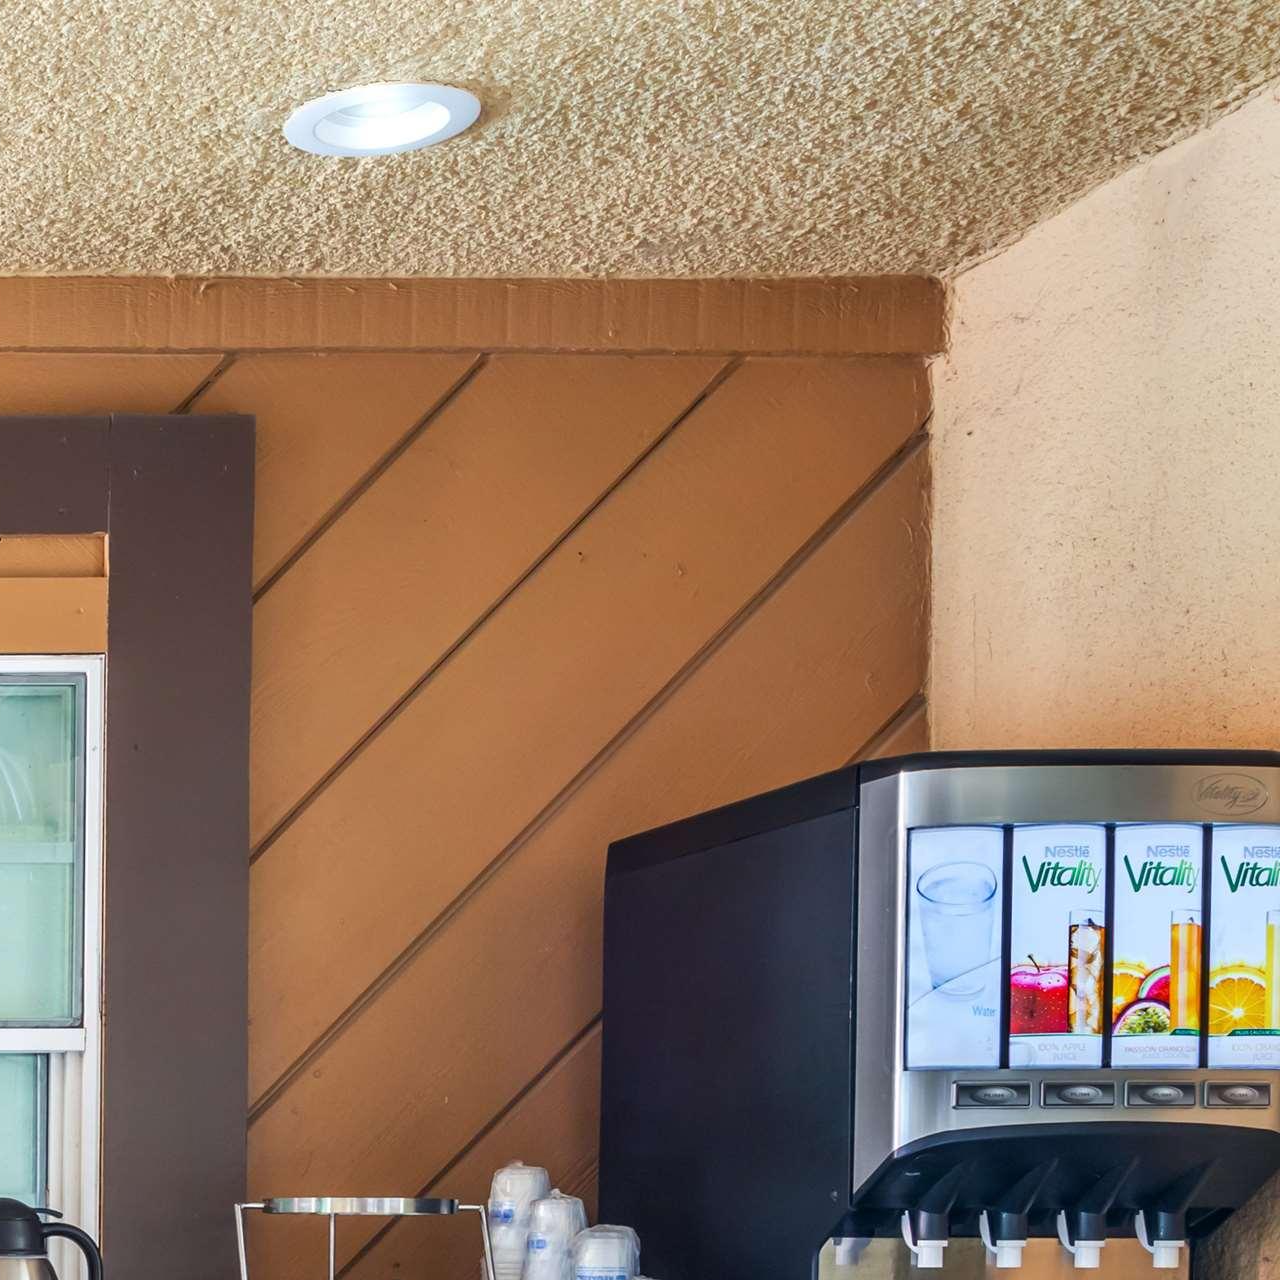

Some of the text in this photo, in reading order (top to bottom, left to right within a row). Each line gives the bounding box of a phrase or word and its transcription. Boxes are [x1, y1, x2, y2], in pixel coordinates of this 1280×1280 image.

[1022, 855, 1102, 894] Vitality
[1124, 855, 1200, 894] Vitality
[972, 1004, 997, 1017] Water
